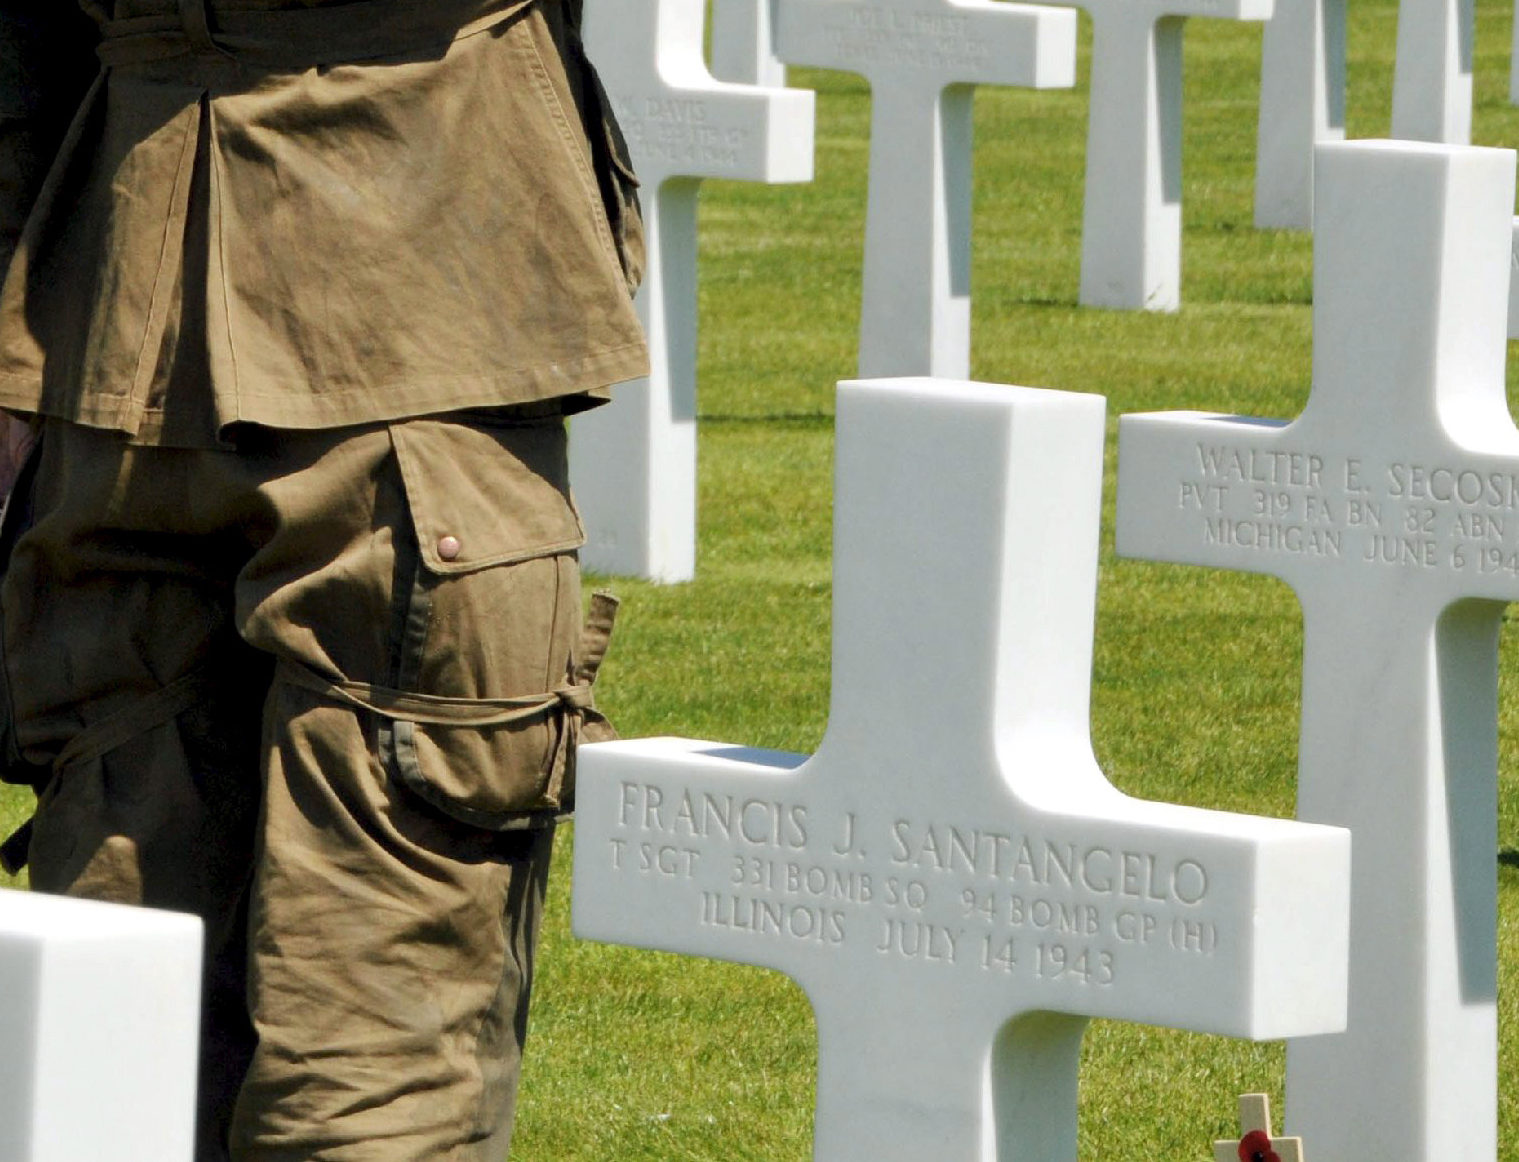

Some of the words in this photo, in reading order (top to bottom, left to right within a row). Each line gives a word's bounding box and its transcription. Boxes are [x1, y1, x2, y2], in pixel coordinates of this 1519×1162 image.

[644, 96, 707, 125] DAVIS
[1196, 443, 1325, 488] WALTER
[1343, 458, 1371, 495] E.
[1178, 481, 1229, 514] PVT
[1251, 489, 1291, 519] 319
[1303, 495, 1333, 524] FA
[1346, 499, 1382, 528] BN
[1404, 506, 1437, 535] 82
[1449, 512, 1504, 542] ABN
[1203, 516, 1342, 558] MICHIGAN
[1362, 534, 1438, 569] JUNE
[1449, 543, 1467, 571] 6
[617, 780, 809, 852] FRANCIS
[833, 811, 868, 860] J.
[889, 817, 1210, 907] SANTANGELO
[609, 837, 627, 871] T
[638, 840, 702, 879] SGT
[731, 853, 774, 892] 331
[785, 860, 875, 905] BOMB
[883, 875, 930, 914] SQ
[960, 886, 999, 924] 94
[1009, 893, 1101, 937] BOMB
[1113, 911, 1159, 945] GP
[1169, 919, 1219, 958] (H)
[699, 890, 847, 944] ILLINOIS
[877, 918, 966, 964] JULY
[981, 934, 1016, 974] 14
[1035, 942, 1115, 989] 1943
